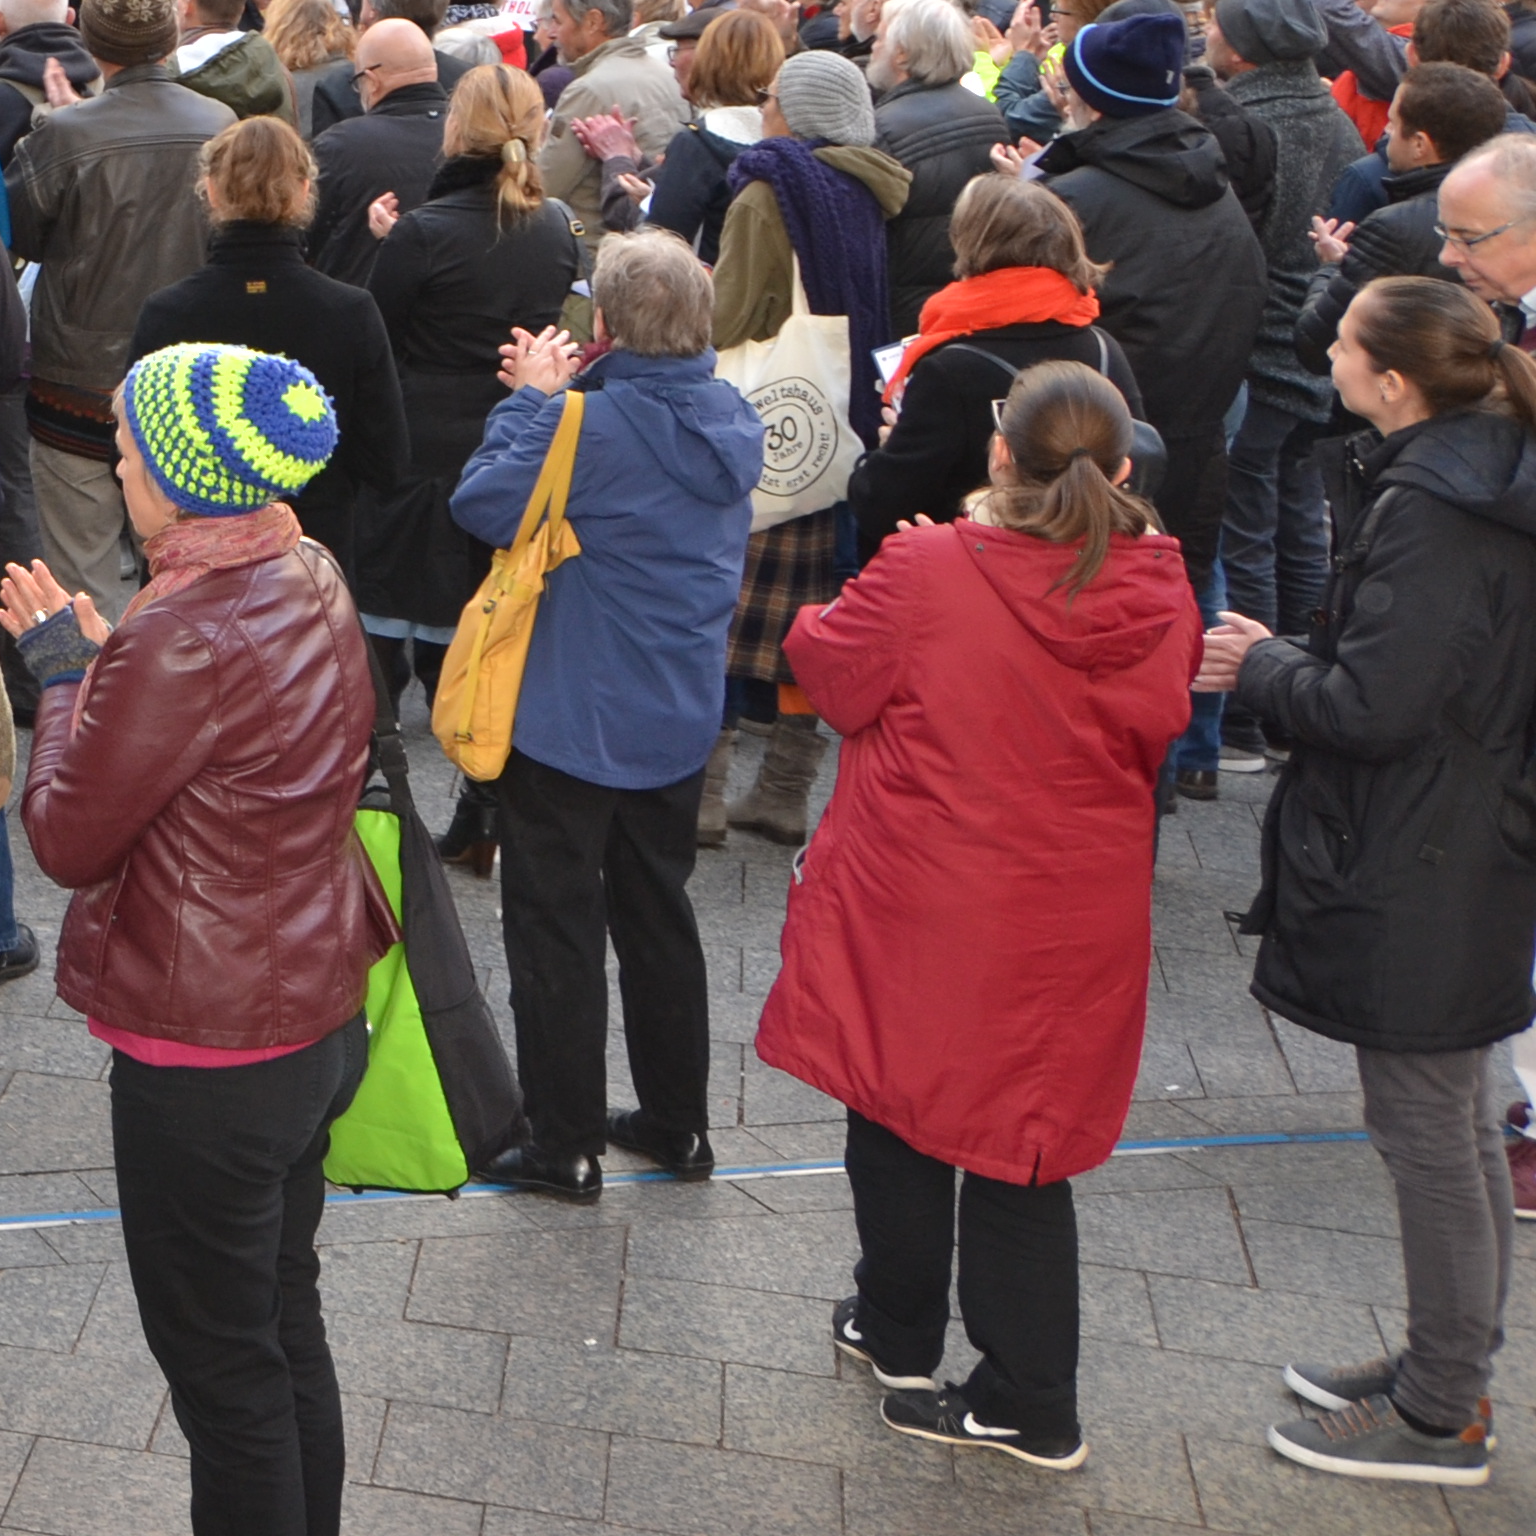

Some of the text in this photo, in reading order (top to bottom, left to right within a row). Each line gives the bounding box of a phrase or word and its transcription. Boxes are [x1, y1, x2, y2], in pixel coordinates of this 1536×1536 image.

[753, 383, 824, 416] weltshaus
[764, 416, 797, 450] 30
[772, 440, 803, 462] Jahre
[762, 468, 810, 488] tzt erst
